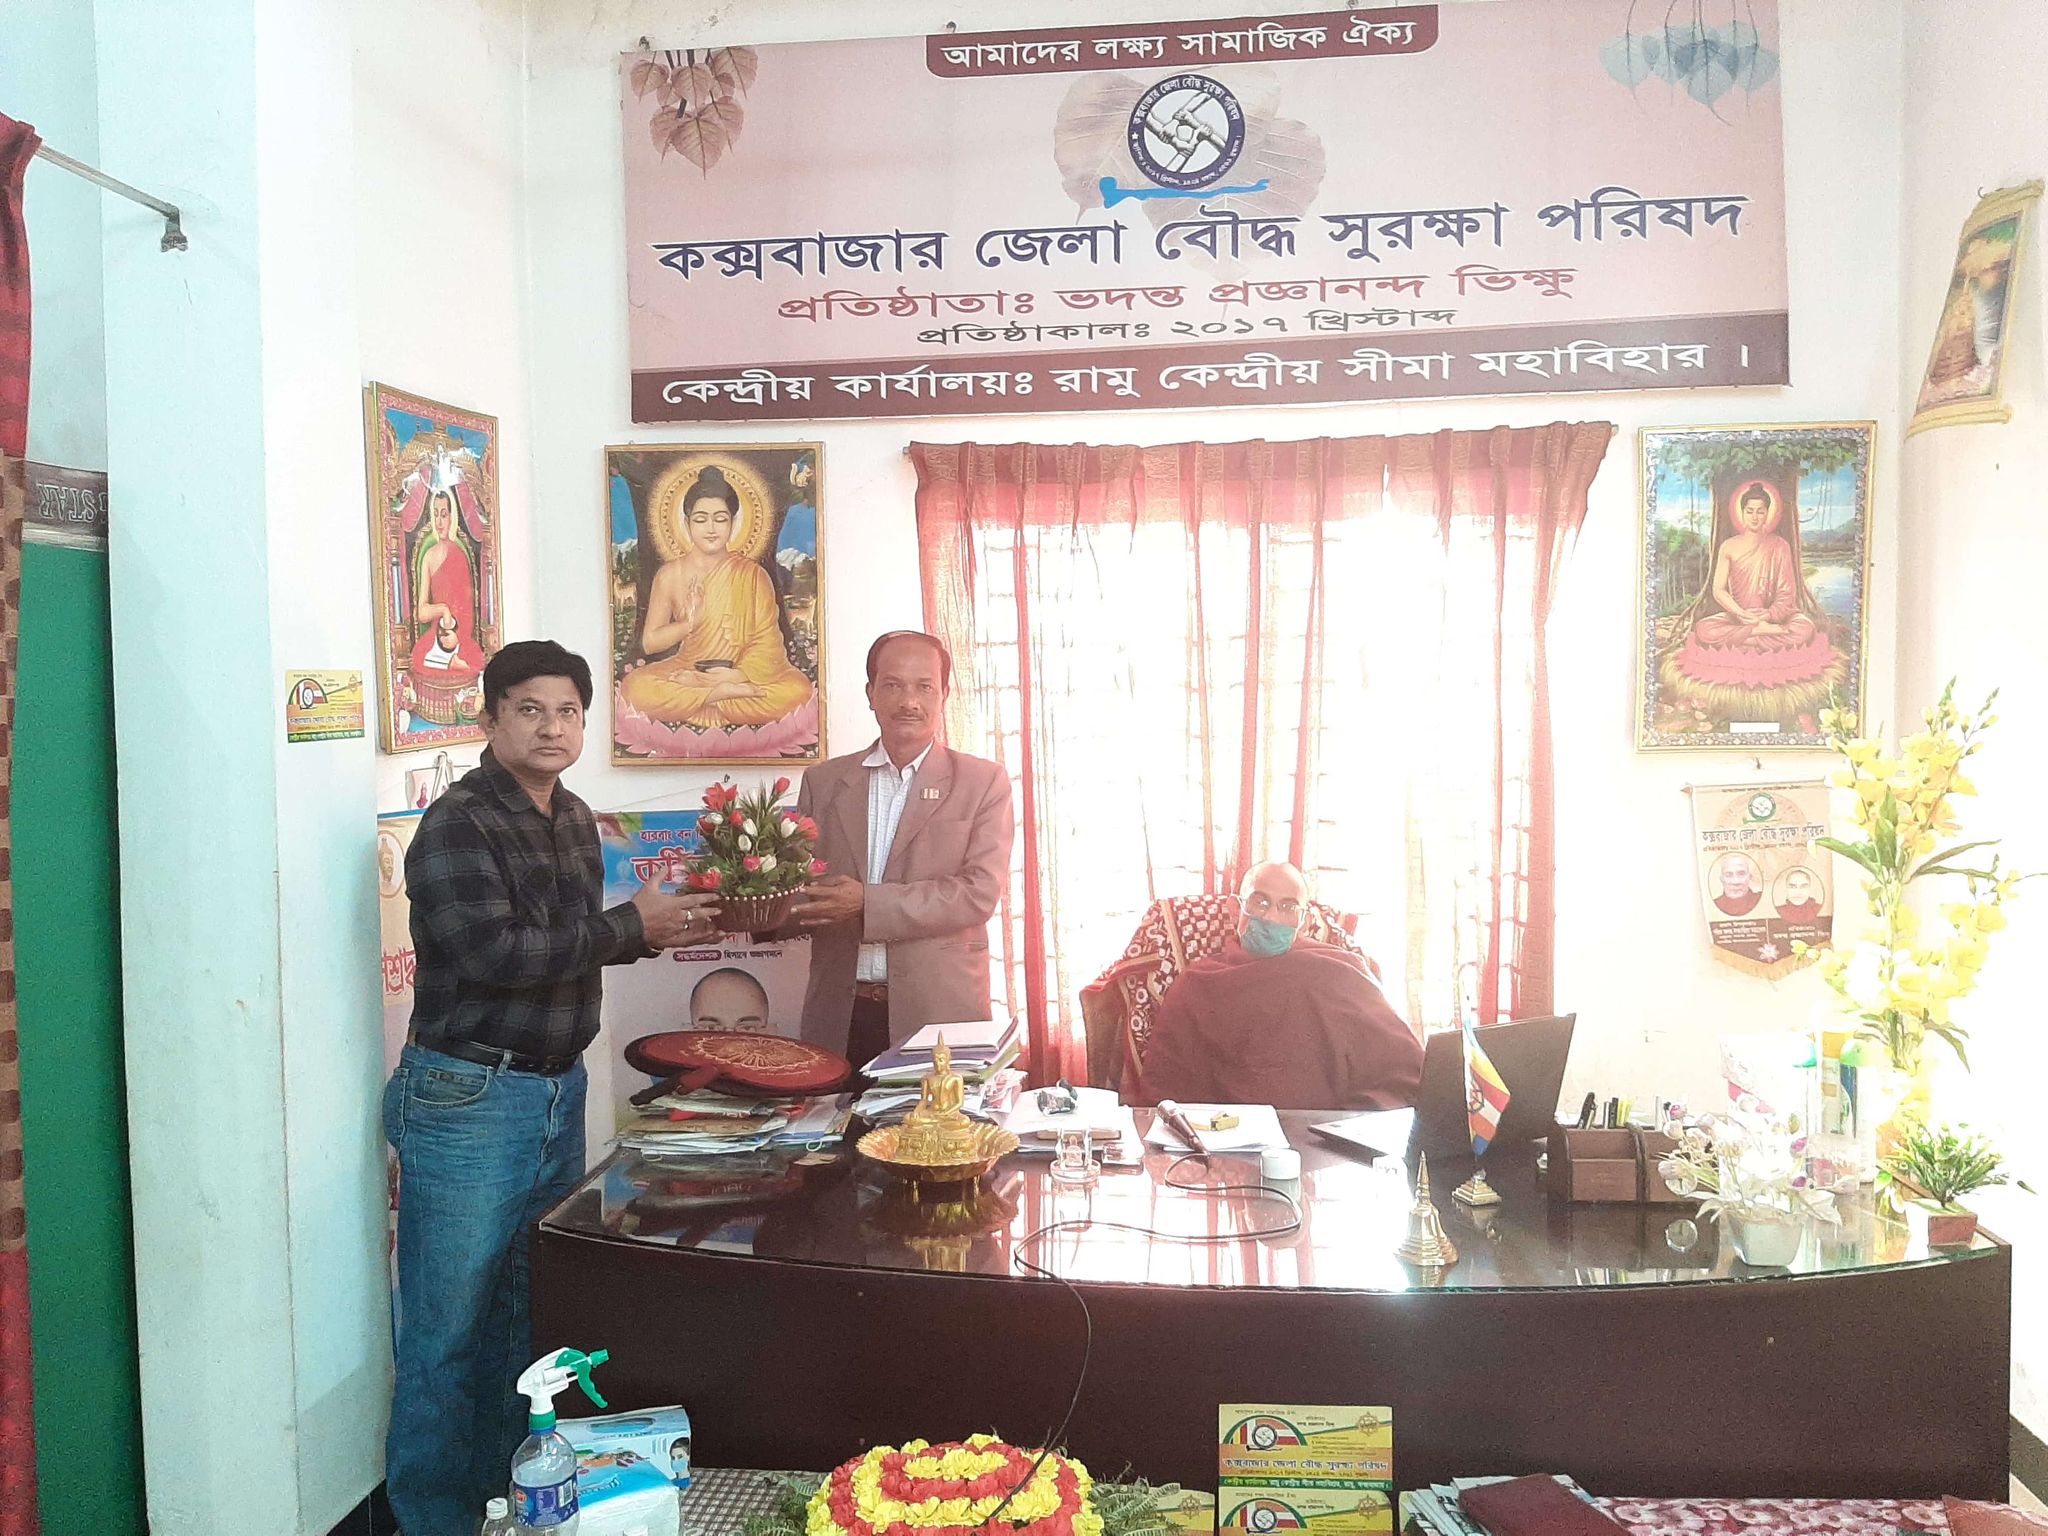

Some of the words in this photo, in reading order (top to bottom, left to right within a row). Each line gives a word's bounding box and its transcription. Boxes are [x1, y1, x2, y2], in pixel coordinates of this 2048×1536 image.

[941, 40, 1081, 68] আমাদের
[1092, 34, 1167, 60] লক্ষ্য
[1178, 24, 1326, 56] সামাজিক
[1342, 15, 1416, 47] ঐক্য
[651, 227, 948, 282] কক্সবাজার
[976, 218, 1128, 265] জেলা
[1155, 203, 1302, 261] বৌদ্ধ
[1323, 200, 1510, 262] সুরক্ষা
[1538, 186, 1749, 242] পরিষদ
[777, 286, 1035, 323] প্রতিষ্ঠাতাঃ
[1054, 286, 1188, 311] ভদন্ত
[1209, 275, 1431, 306] প্রজ্ঞানন্দ
[1449, 264, 1579, 299] ভিক্ষু
[916, 321, 1150, 345] প্রতিষ্ঠাকালঃ
[1171, 316, 1288, 338] ২০১৭
[1305, 307, 1458, 332] খ্রিস্টাব্দ
[662, 368, 815, 405] কেন্দ্রীয়
[829, 364, 1033, 397] কার্যালয়ঃ
[1050, 366, 1143, 398] রামু
[1158, 351, 1323, 391] কেন্দ্রীয়
[1338, 348, 1455, 383] সীমা
[1471, 339, 1710, 378] মহাবিহার
